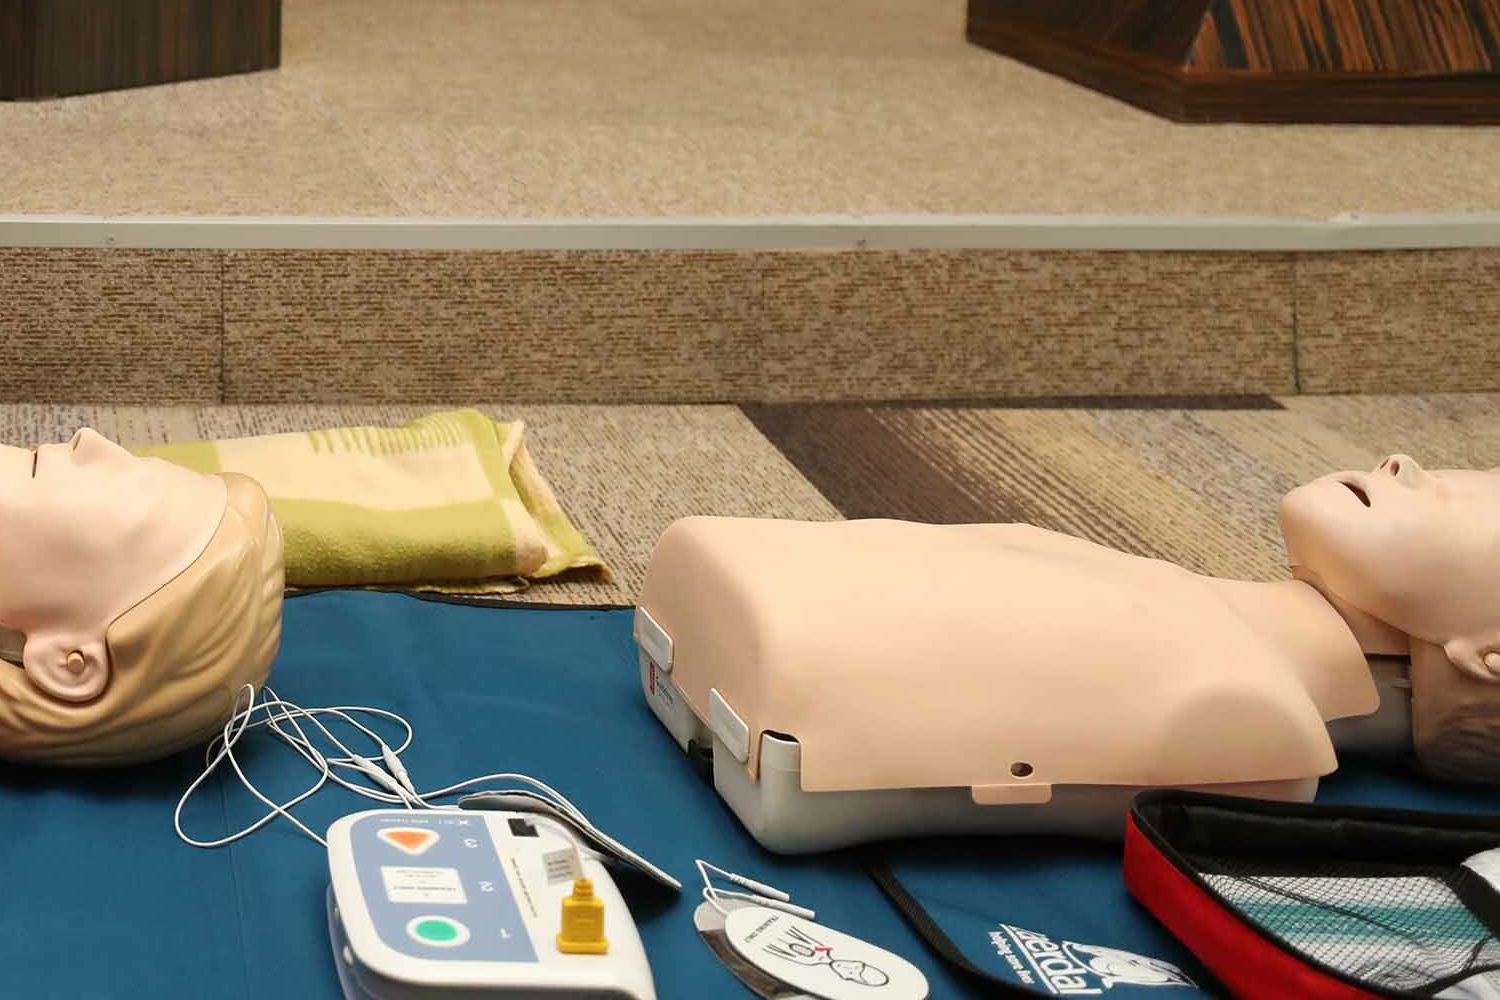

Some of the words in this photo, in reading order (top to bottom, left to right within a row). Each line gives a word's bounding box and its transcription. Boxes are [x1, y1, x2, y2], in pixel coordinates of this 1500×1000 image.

[463, 838, 478, 848] 3
[477, 880, 495, 892] 2
[500, 926, 512, 939] 1
